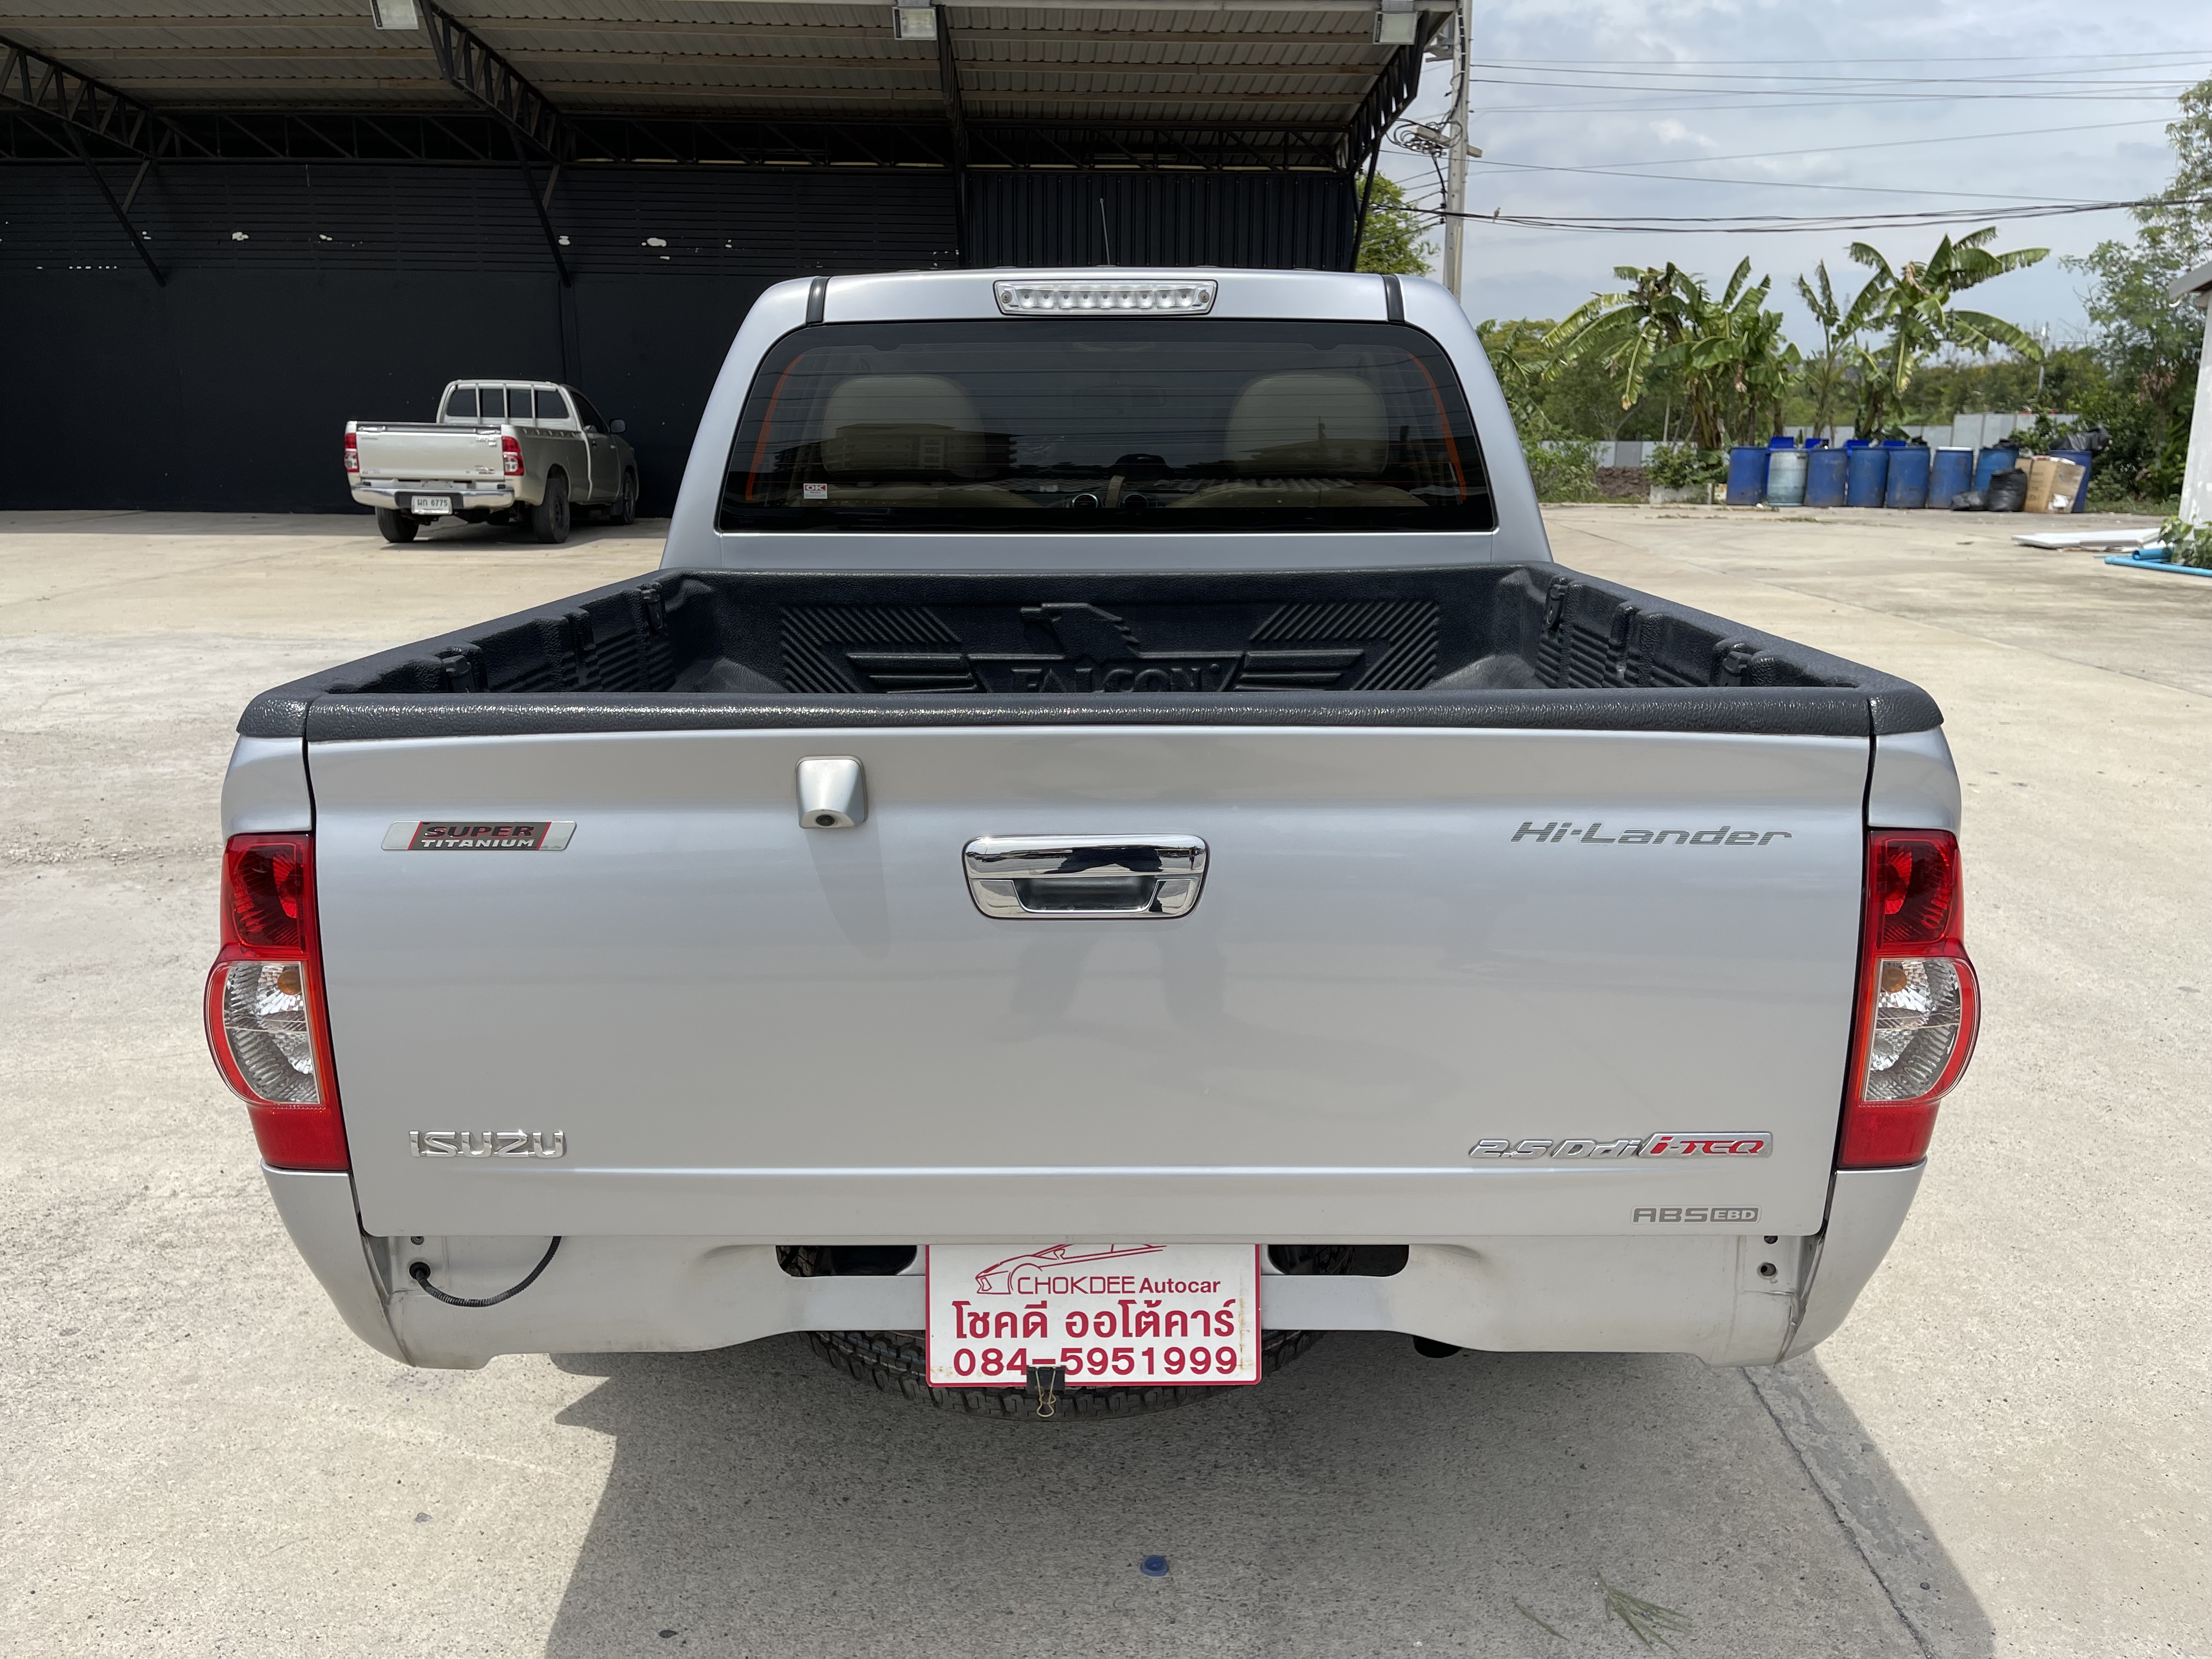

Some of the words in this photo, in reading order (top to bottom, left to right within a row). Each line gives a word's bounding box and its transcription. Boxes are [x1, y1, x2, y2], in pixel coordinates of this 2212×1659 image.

[424, 826, 536, 839] SUPER
[421, 839, 534, 848] TITANIUM
[409, 1130, 566, 1158] ISUZU
[1633, 1207, 1709, 1223] ABS
[1712, 1209, 1757, 1222] EBD
[1017, 1276, 1136, 1294] CHOKDEE
[1139, 1277, 1221, 1294] Autocar
[952, 1300, 1048, 1339] โชคดี
[1065, 1299, 1237, 1338] ออโต้คาร์
[953, 1346, 1237, 1376] 084-5951999
